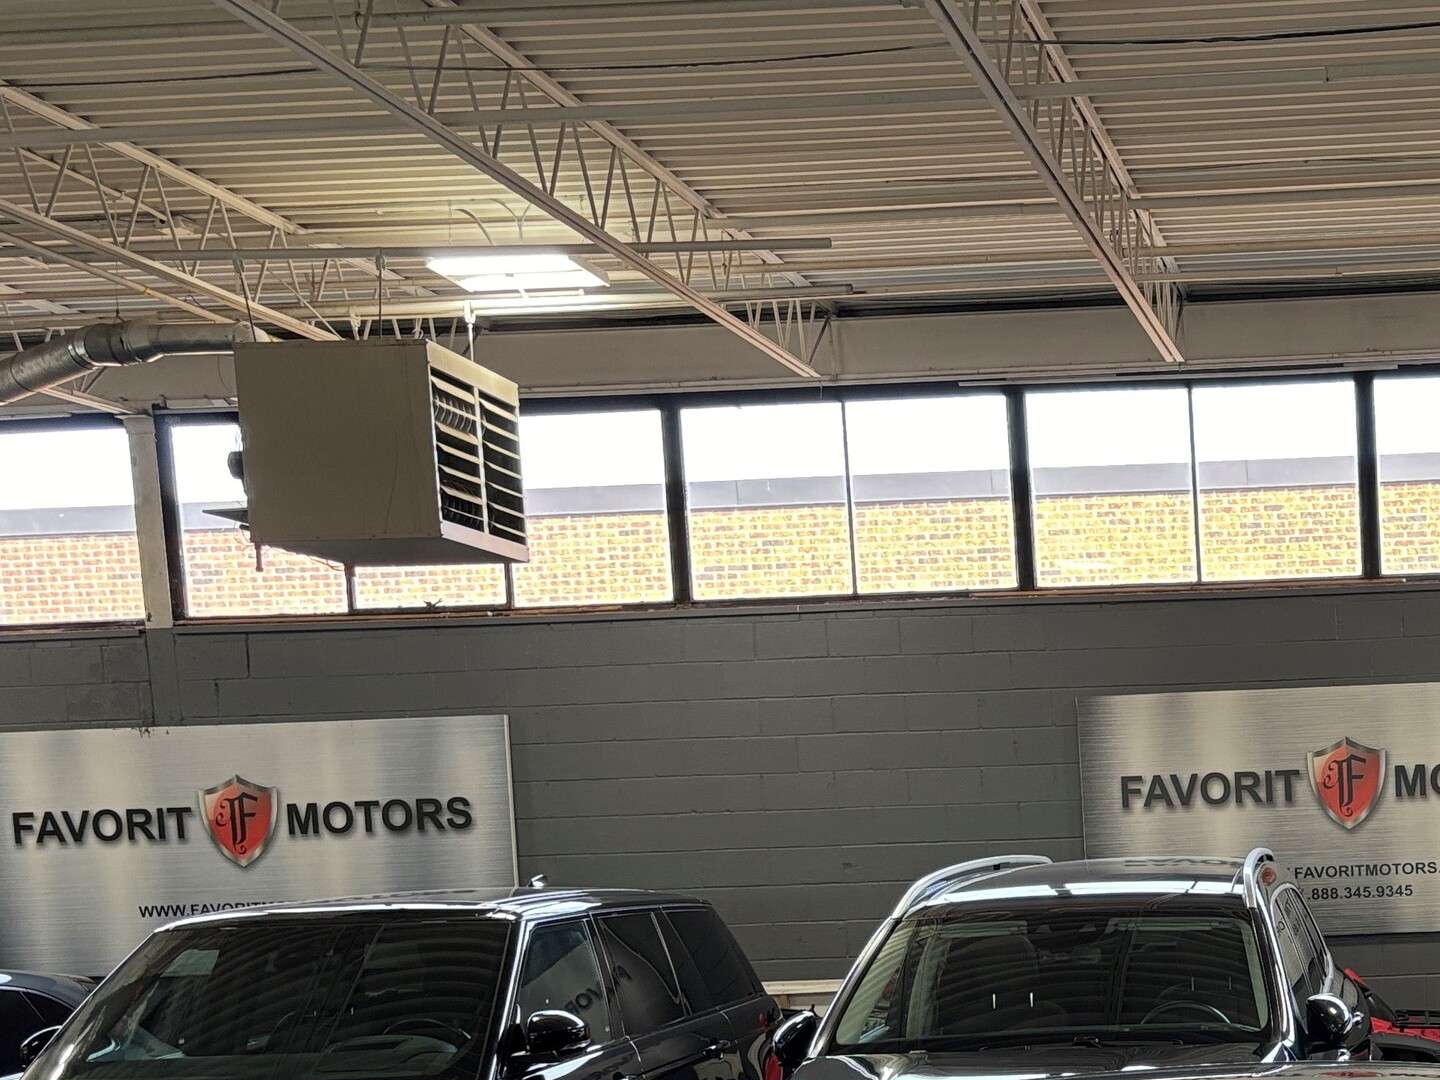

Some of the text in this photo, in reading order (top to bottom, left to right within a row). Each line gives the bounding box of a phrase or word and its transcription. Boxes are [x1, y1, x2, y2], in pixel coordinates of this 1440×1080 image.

[1121, 769, 1300, 809] FAVORIT
[12, 806, 192, 846] FAVORIT
[286, 796, 473, 836] MOTORS
[1306, 884, 1413, 901] .888.345.9345
